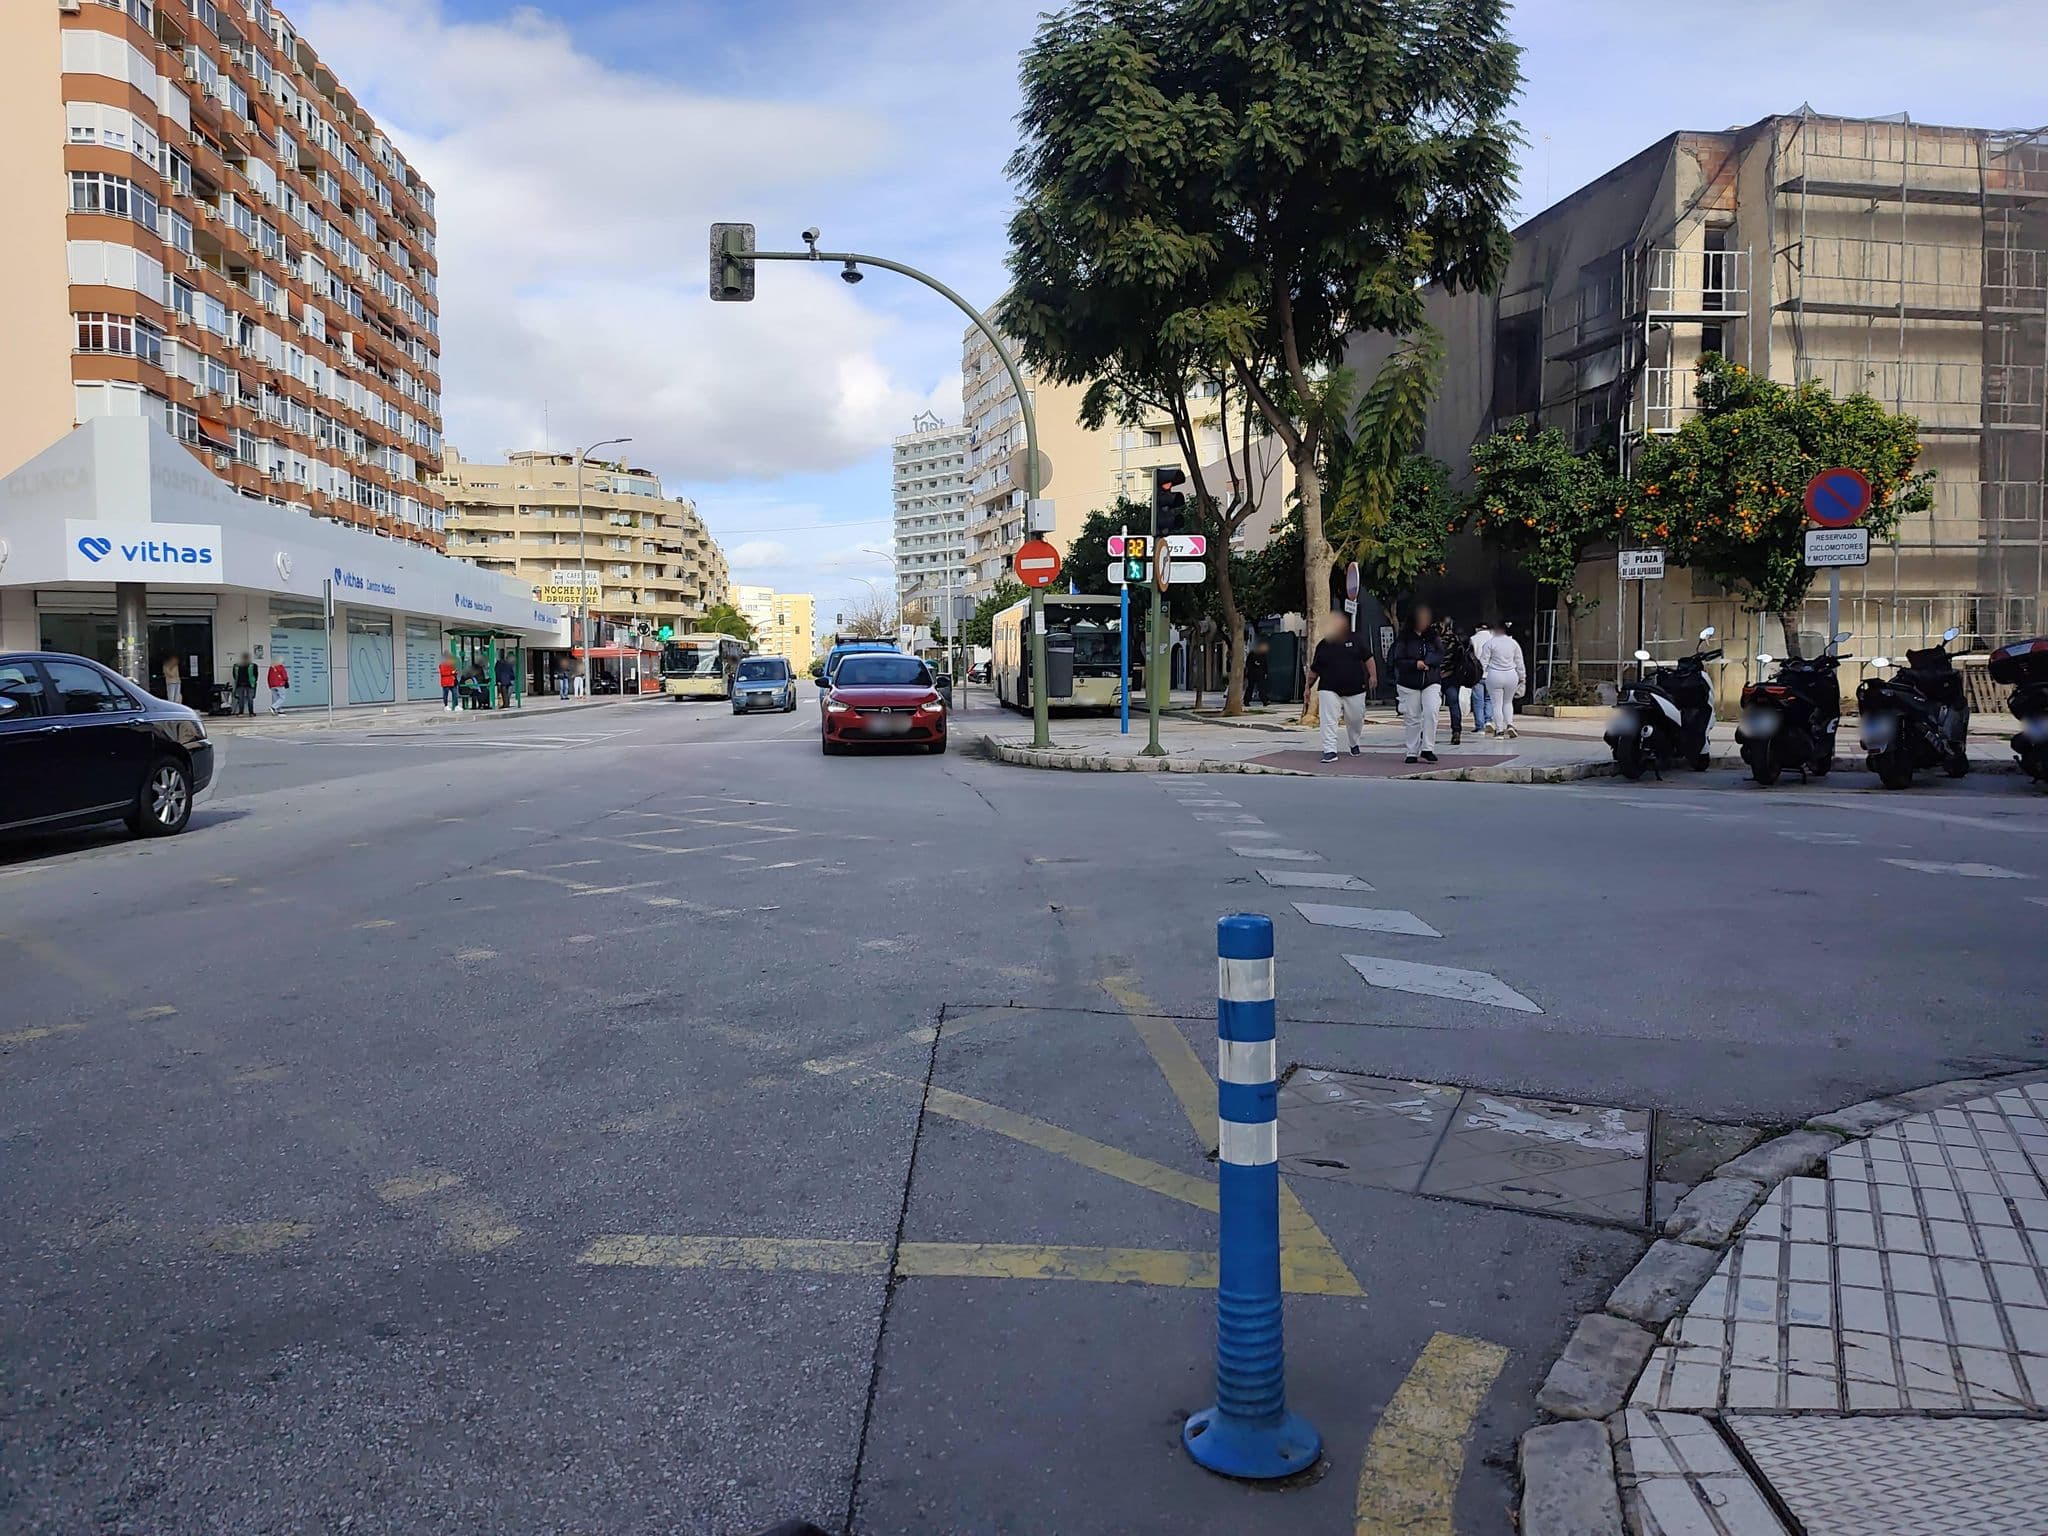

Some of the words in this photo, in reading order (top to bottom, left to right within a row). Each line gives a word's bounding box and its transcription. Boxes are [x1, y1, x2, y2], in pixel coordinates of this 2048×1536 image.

[1816, 533, 1857, 541] RESERVADO
[1809, 543, 1863, 551] CICLOMOTORES
[121, 541, 213, 563] vithas
[1635, 555, 1658, 563] PLAZA
[1813, 553, 1865, 561] MOTOCICLETAS
[343, 571, 364, 589] vithas
[544, 585, 574, 594] NOCHE
